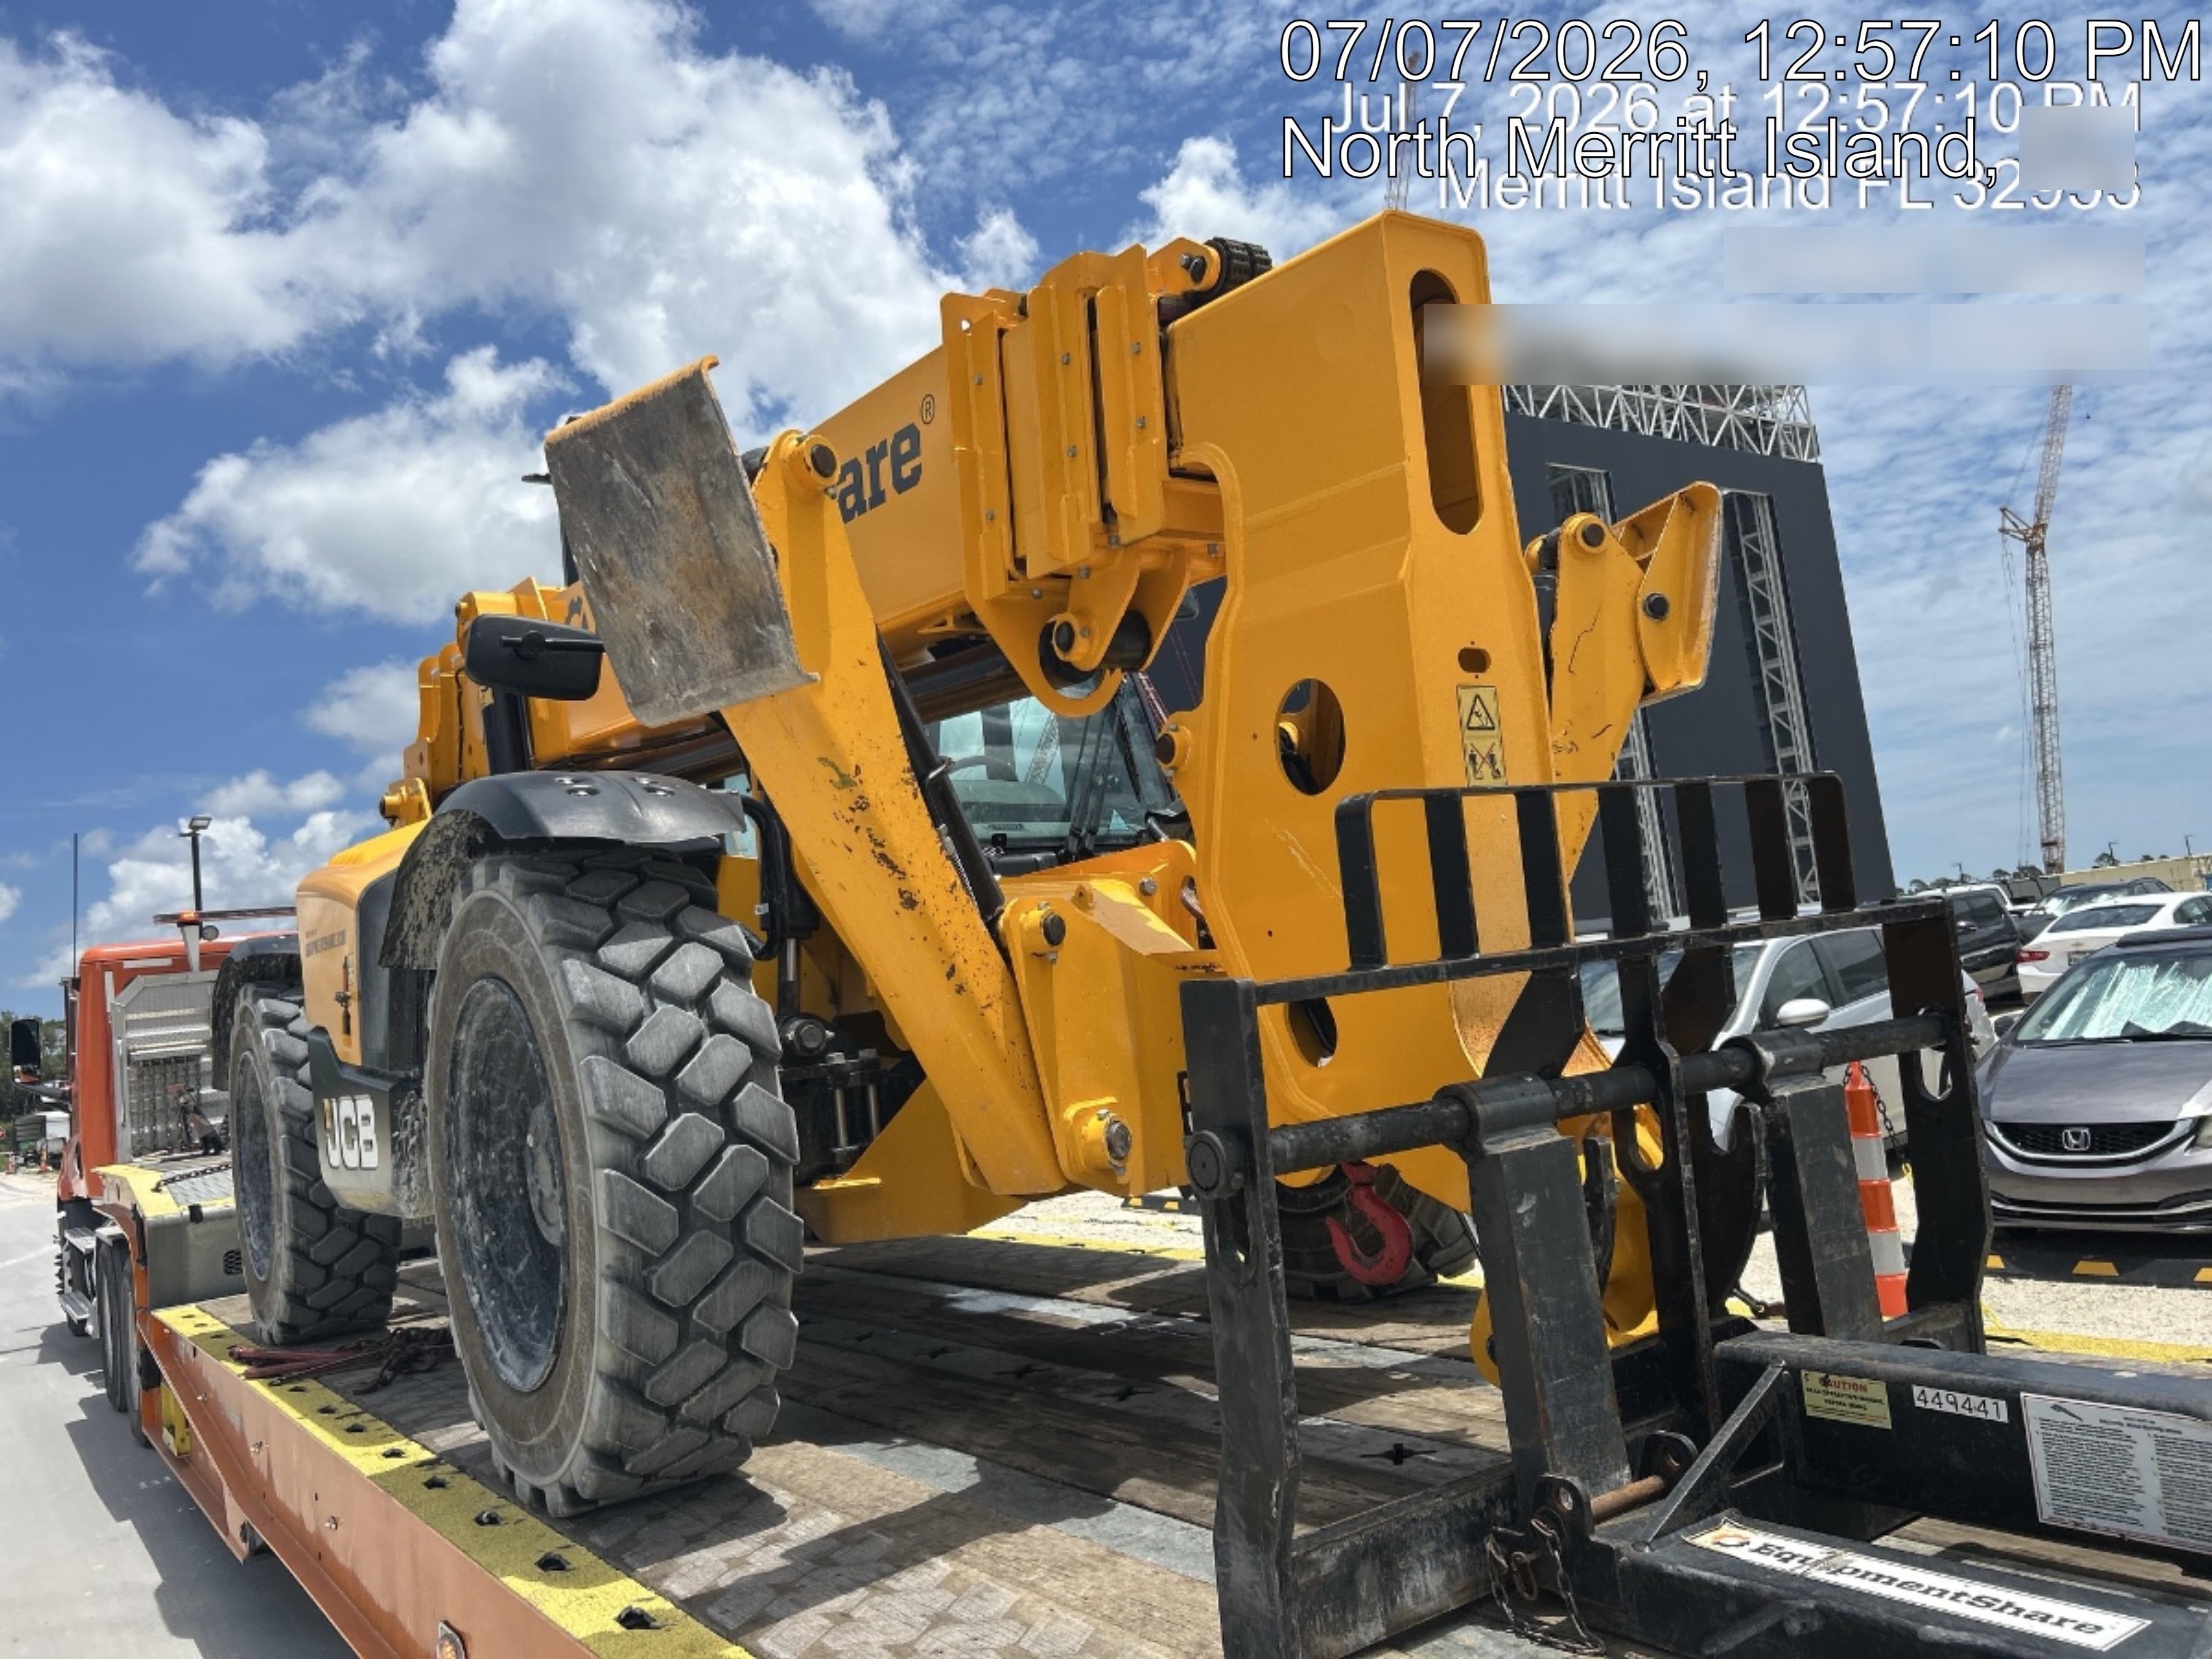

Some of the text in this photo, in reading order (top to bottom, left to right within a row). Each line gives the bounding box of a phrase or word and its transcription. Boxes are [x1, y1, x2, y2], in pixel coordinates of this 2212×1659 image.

[323, 1094, 379, 1170] JCB
[1916, 1389, 2001, 1419] 449441
[1749, 1543, 2104, 1634] EqupmentShare
